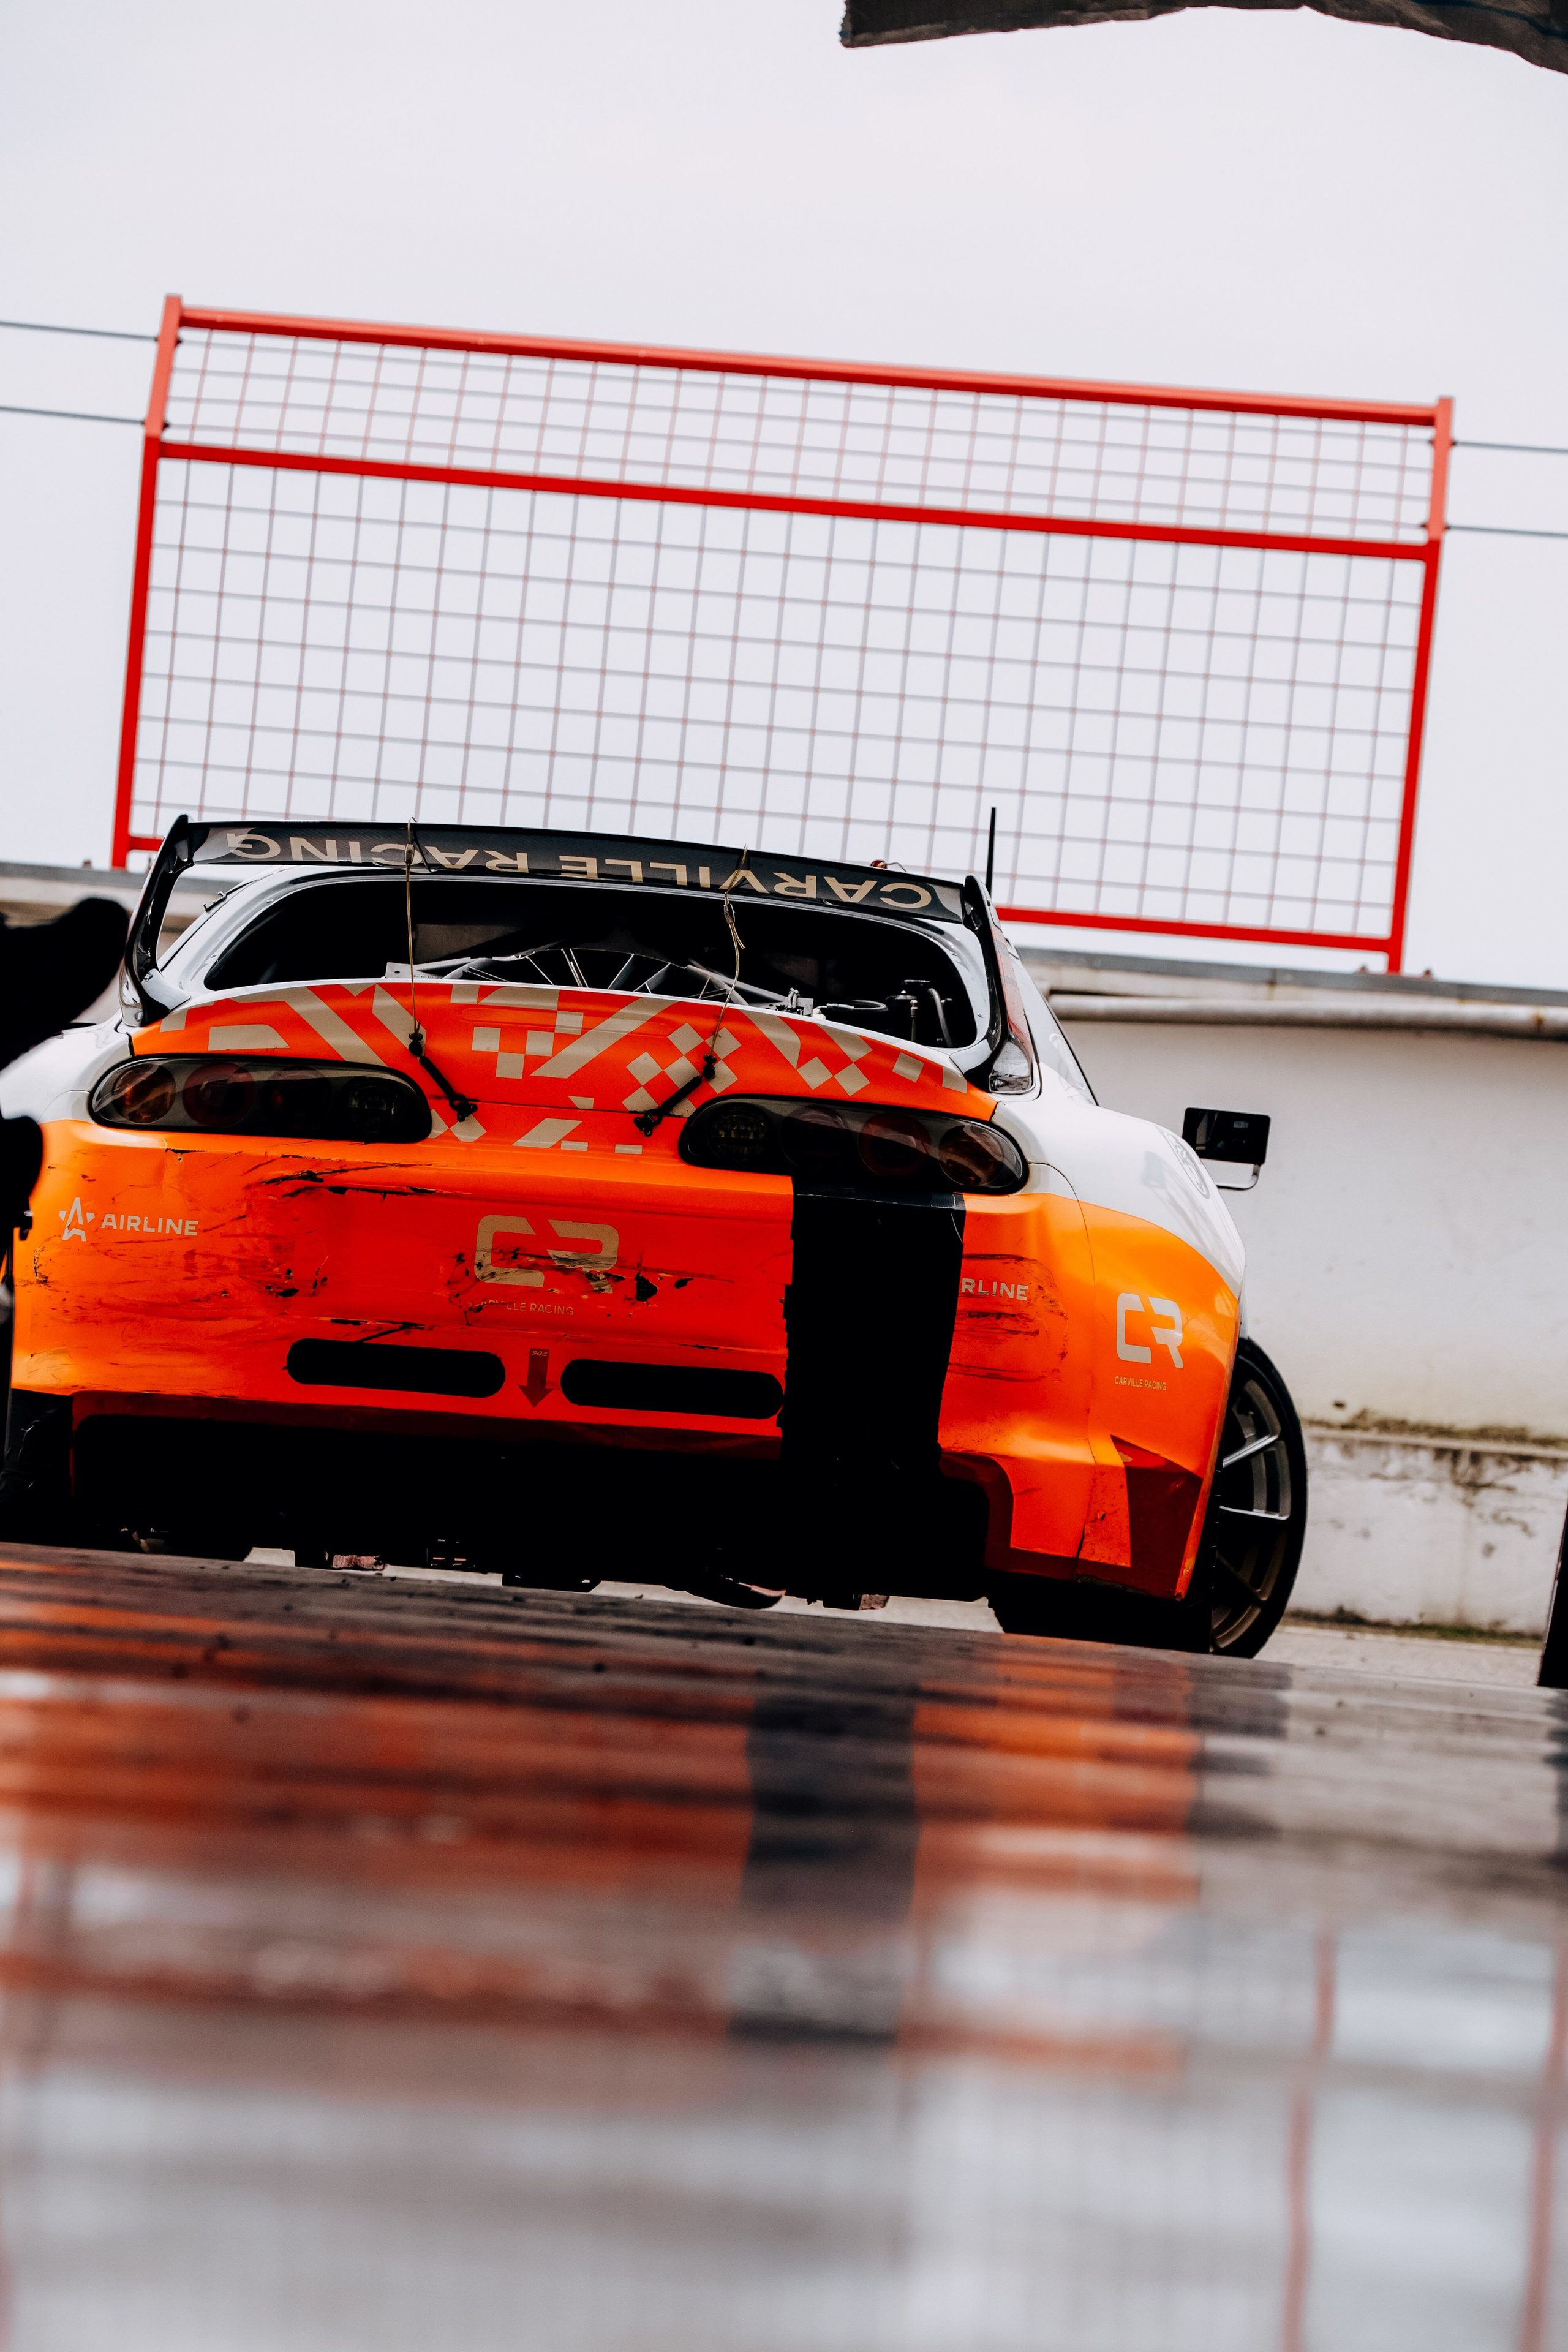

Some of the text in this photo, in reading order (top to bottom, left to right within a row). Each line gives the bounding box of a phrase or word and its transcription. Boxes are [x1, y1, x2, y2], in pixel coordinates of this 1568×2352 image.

[226, 833, 932, 909] CARVILLE RACING
[100, 1213, 199, 1236] AIRLINE
[530, 1303, 574, 1315] RACING
[1114, 1376, 1167, 1390] CARVILLE RACING
